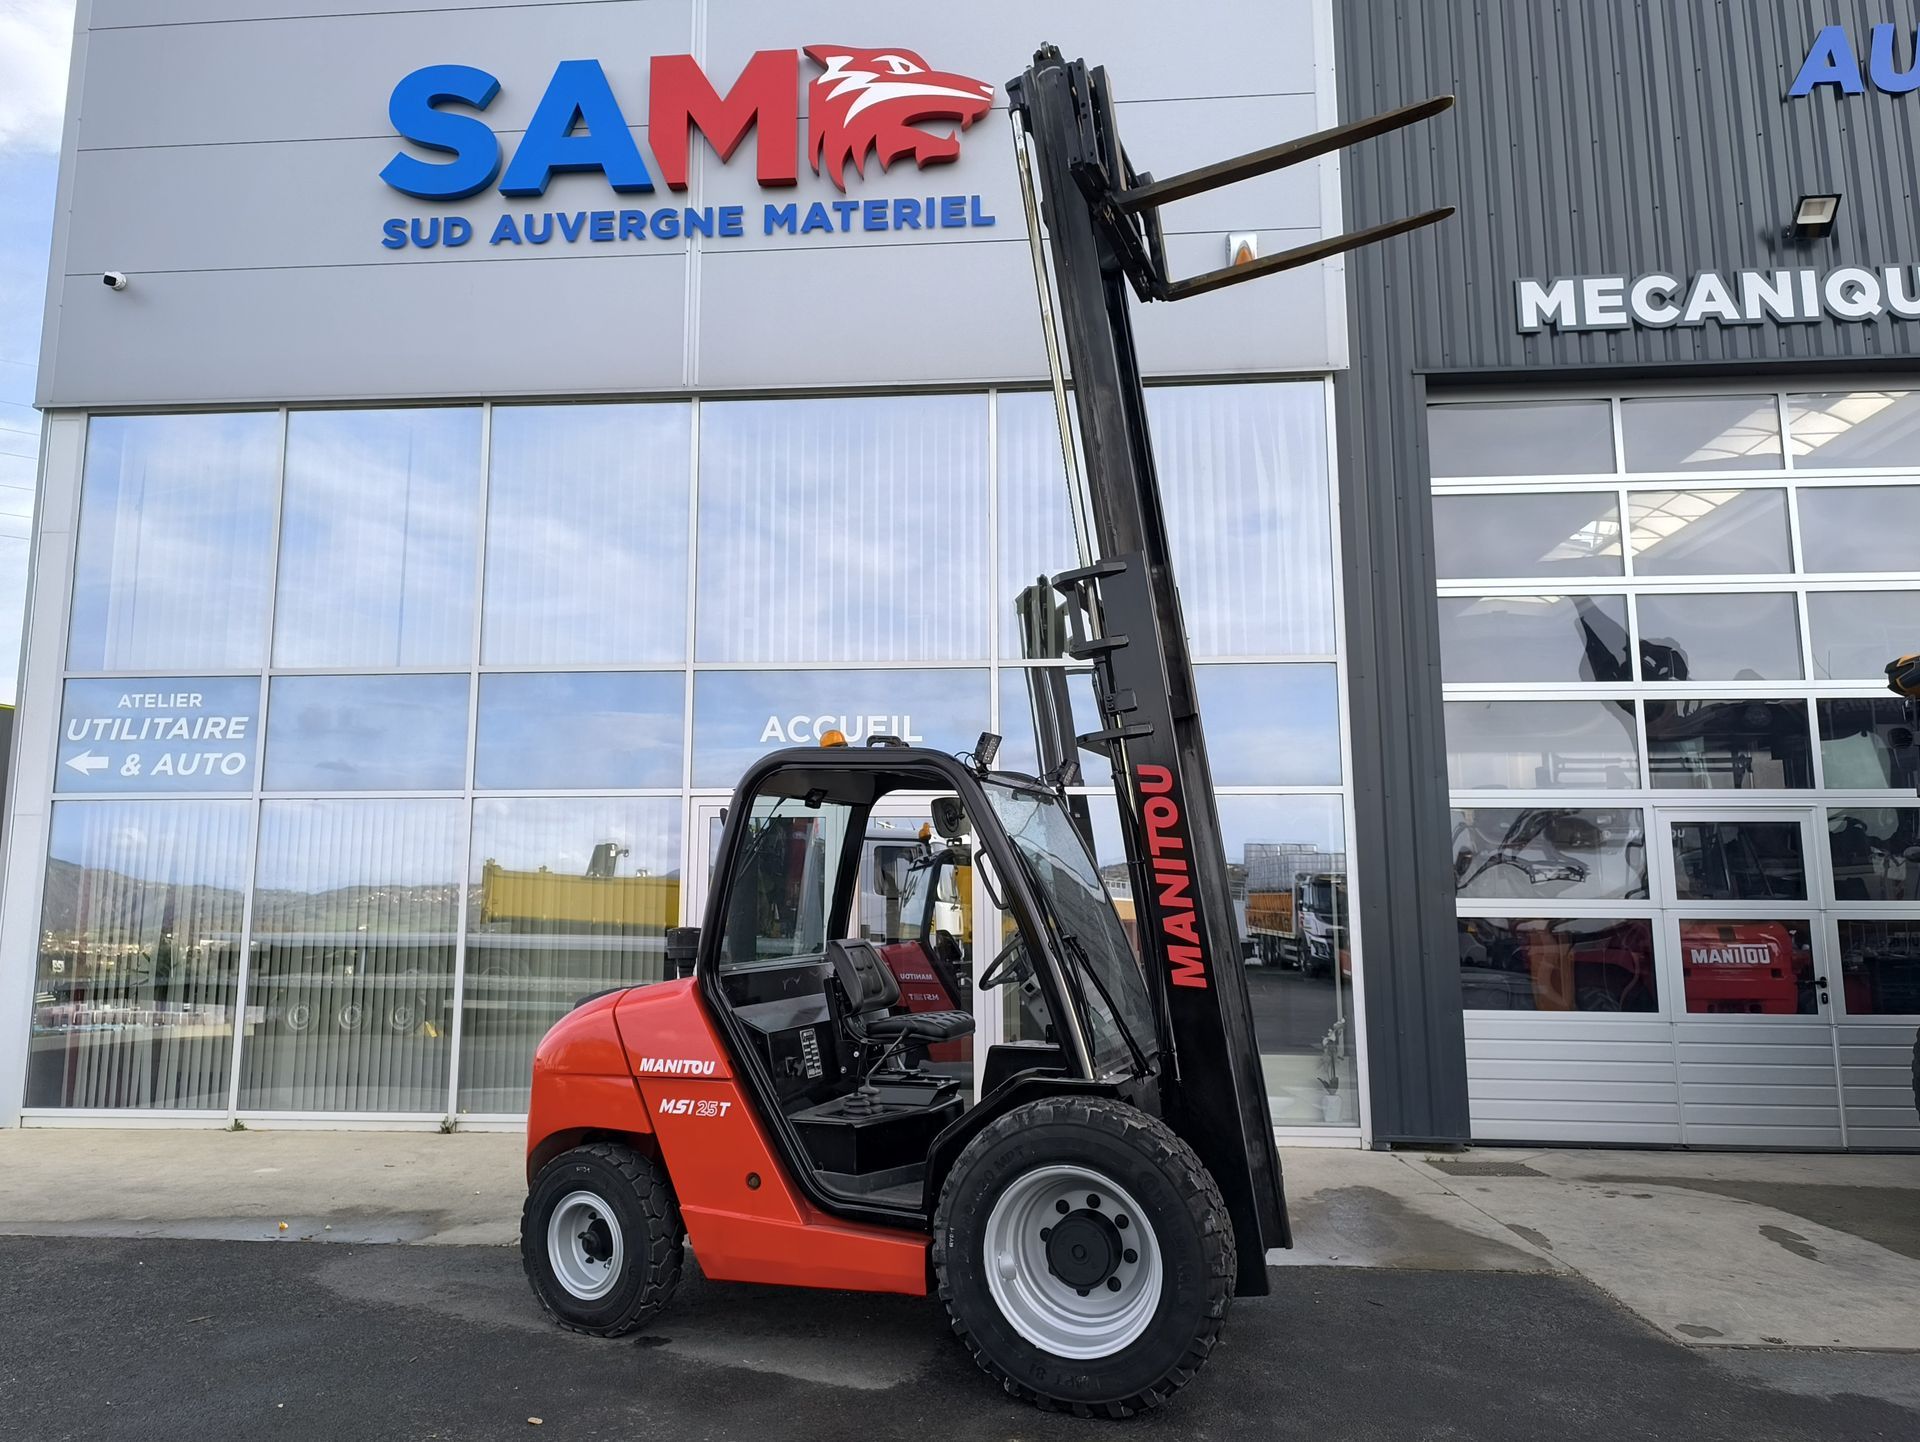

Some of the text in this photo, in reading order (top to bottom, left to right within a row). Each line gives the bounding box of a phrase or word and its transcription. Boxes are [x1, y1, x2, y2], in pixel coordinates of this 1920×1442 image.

[1788, 24, 1920, 95] AU
[379, 49, 798, 199] SAM
[382, 194, 996, 249] SUD AUVERGNE MATERIEL
[1518, 266, 1920, 329] MECANIQU
[117, 693, 203, 709] ATELIER
[66, 716, 250, 742] UTILITAIRE
[759, 715, 923, 743] ACCUEIL
[120, 752, 247, 777] & AUTO
[1136, 764, 1208, 989] MANITOU
[1690, 943, 1772, 965] MANITOU
[639, 1057, 716, 1075] MANITOU
[658, 1098, 695, 1116] MSI
